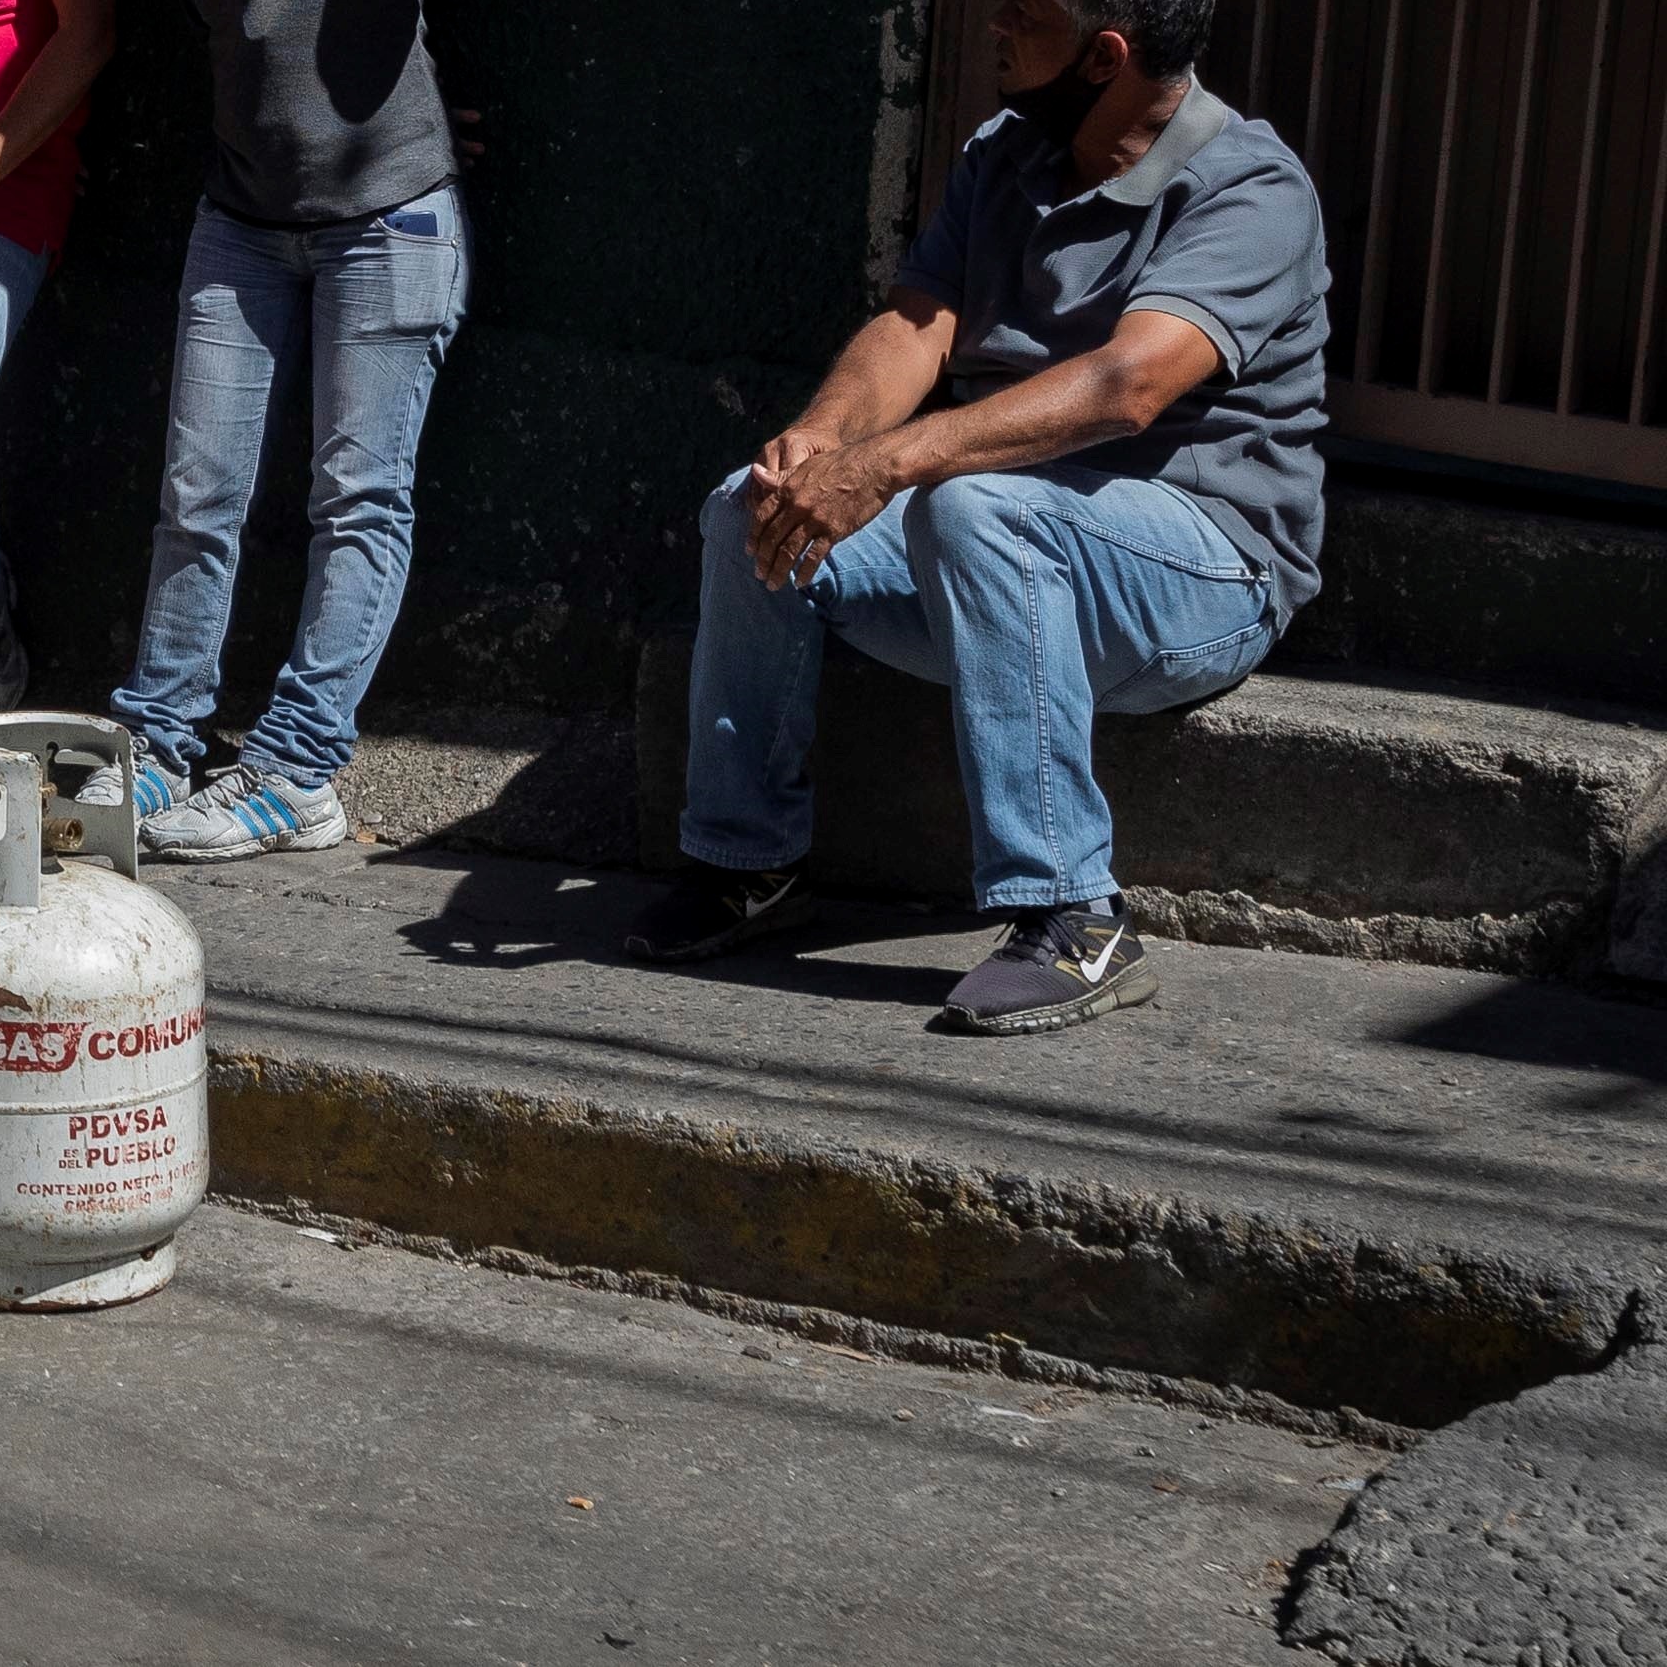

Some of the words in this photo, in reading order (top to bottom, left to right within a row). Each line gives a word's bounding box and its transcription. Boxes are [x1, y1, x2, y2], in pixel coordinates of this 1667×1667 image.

[68, 1105, 168, 1141] PDVSA
[58, 1159, 83, 1170] DEL
[85, 1134, 177, 1169] PUEBLO
[16, 1183, 118, 1197] CONTENIDO
